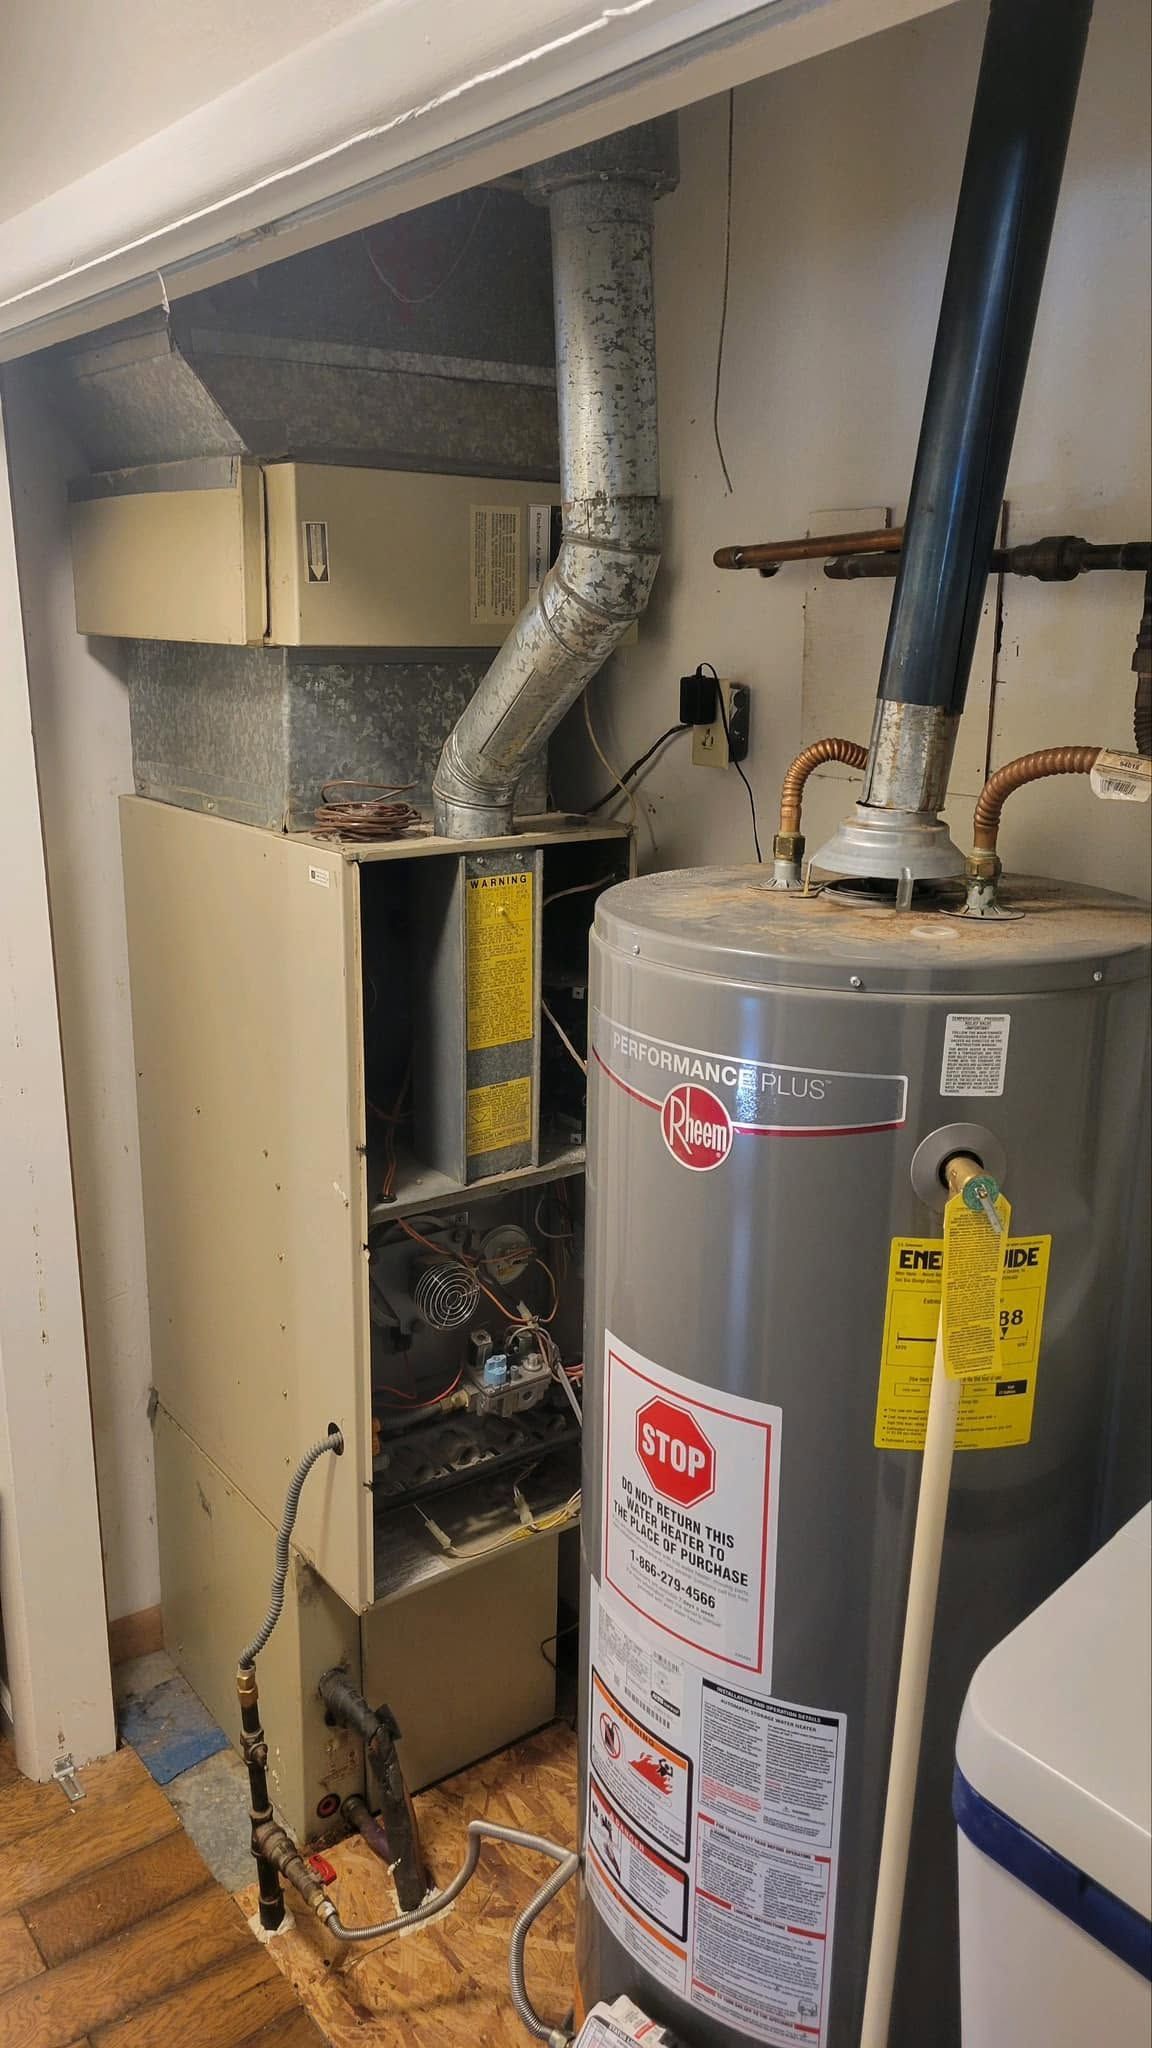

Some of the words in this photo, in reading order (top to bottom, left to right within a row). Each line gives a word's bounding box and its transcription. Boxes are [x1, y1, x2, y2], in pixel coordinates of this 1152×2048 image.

[470, 874, 527, 889] WARNING
[613, 1031, 754, 1089] PERFORMANCE
[669, 1086, 727, 1155] Rheem
[642, 1422, 706, 1478] STOP
[614, 1500, 628, 1522] THE
[630, 1516, 660, 1546] PLACE
[663, 1539, 677, 1555] OF
[680, 1548, 749, 1588] PURCHASE
[621, 1476, 633, 1494] DO
[635, 1486, 654, 1509] NOT
[656, 1502, 701, 1535] RETURN
[705, 1526, 735, 1549] THIS
[626, 1496, 657, 1529] WATER
[660, 1521, 704, 1554] HEATER
[708, 1544, 725, 1562] TO
[630, 1549, 716, 1609] 1-866-279-4566
